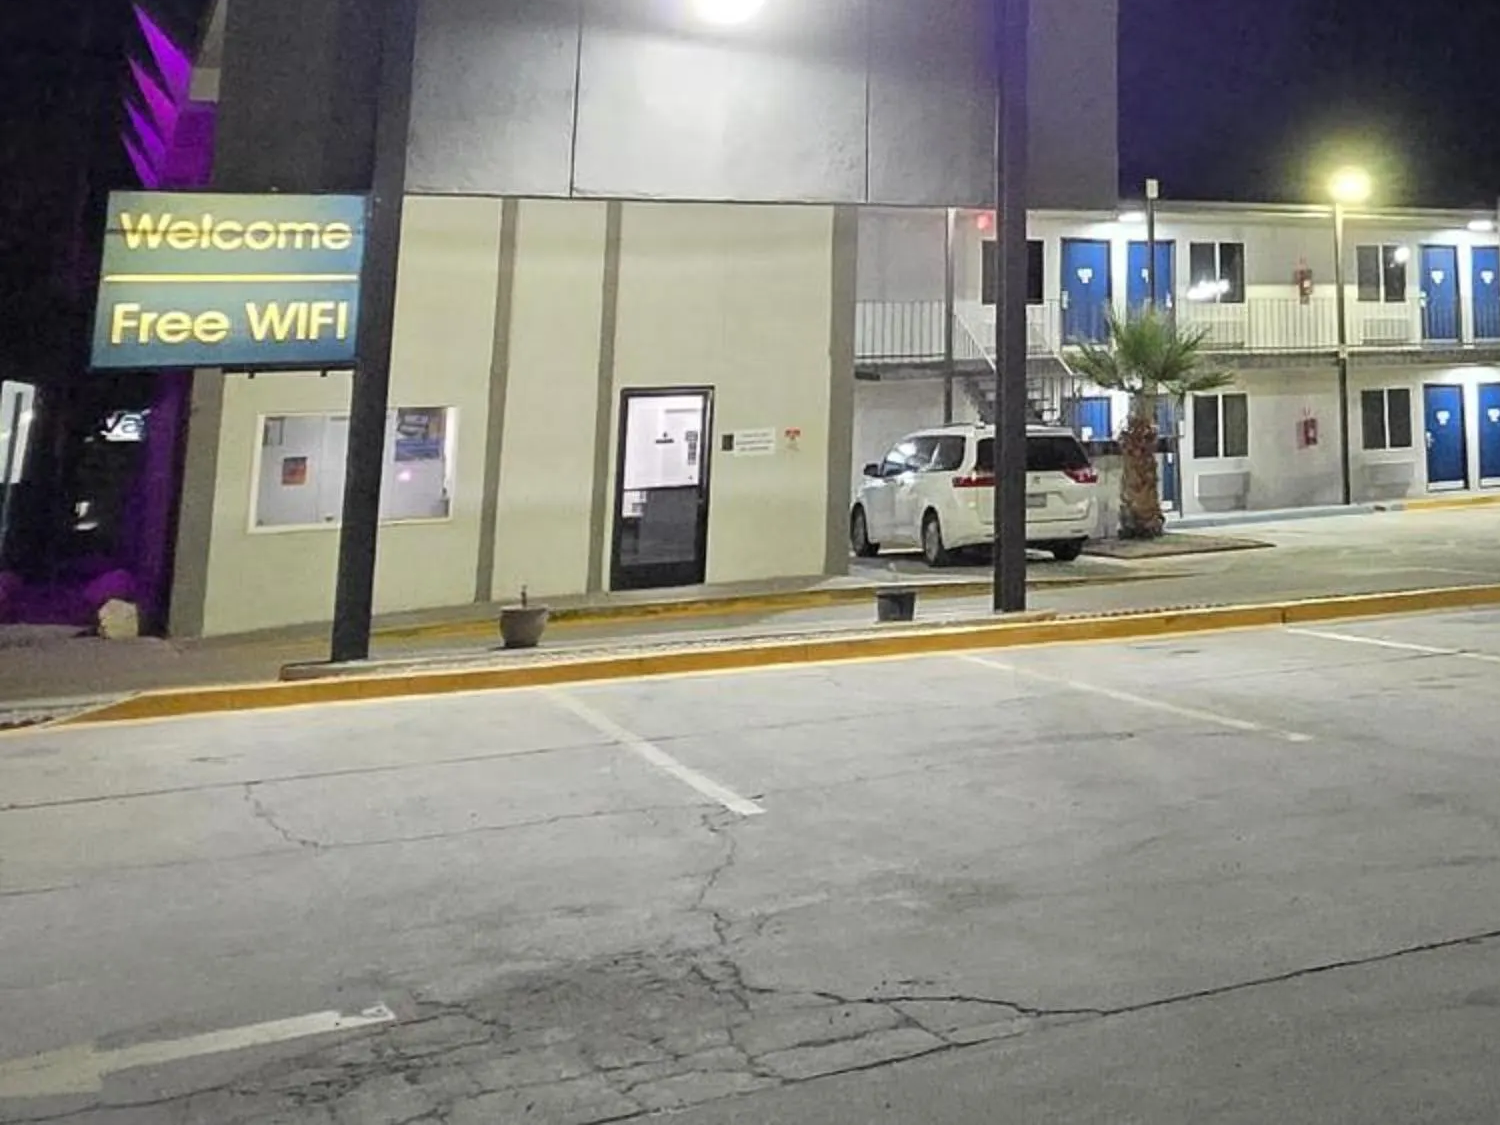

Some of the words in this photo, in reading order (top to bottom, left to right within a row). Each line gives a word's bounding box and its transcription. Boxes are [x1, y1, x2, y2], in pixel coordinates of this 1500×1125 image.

[120, 212, 353, 251] Welcome
[110, 303, 231, 345] Free
[245, 301, 349, 342] WIFI
